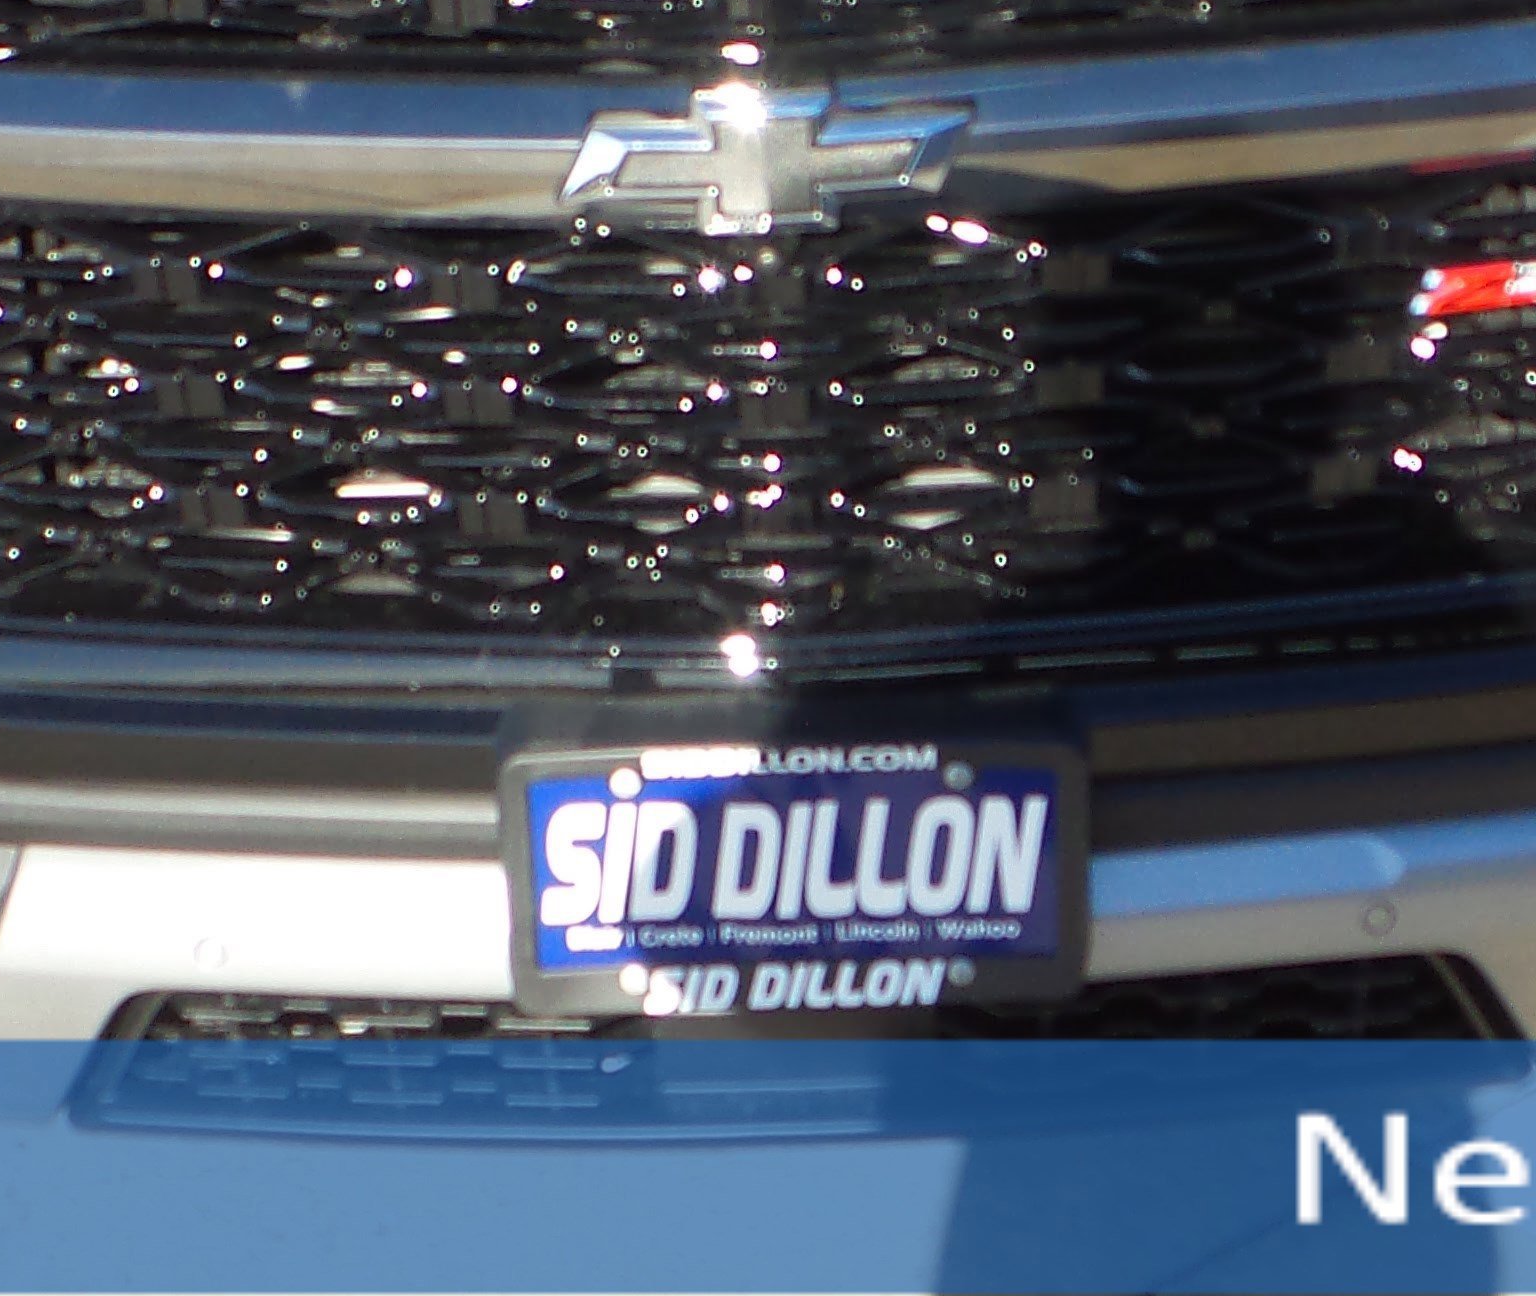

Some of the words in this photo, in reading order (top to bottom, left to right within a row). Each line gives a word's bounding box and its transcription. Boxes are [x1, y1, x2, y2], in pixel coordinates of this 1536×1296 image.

[640, 744, 939, 780] LLON.COM
[540, 800, 699, 927] SID
[712, 793, 1050, 921] DILLON
[935, 916, 1022, 940] Wahoo
[642, 962, 741, 1016] SID
[747, 956, 948, 1012] DILLON
